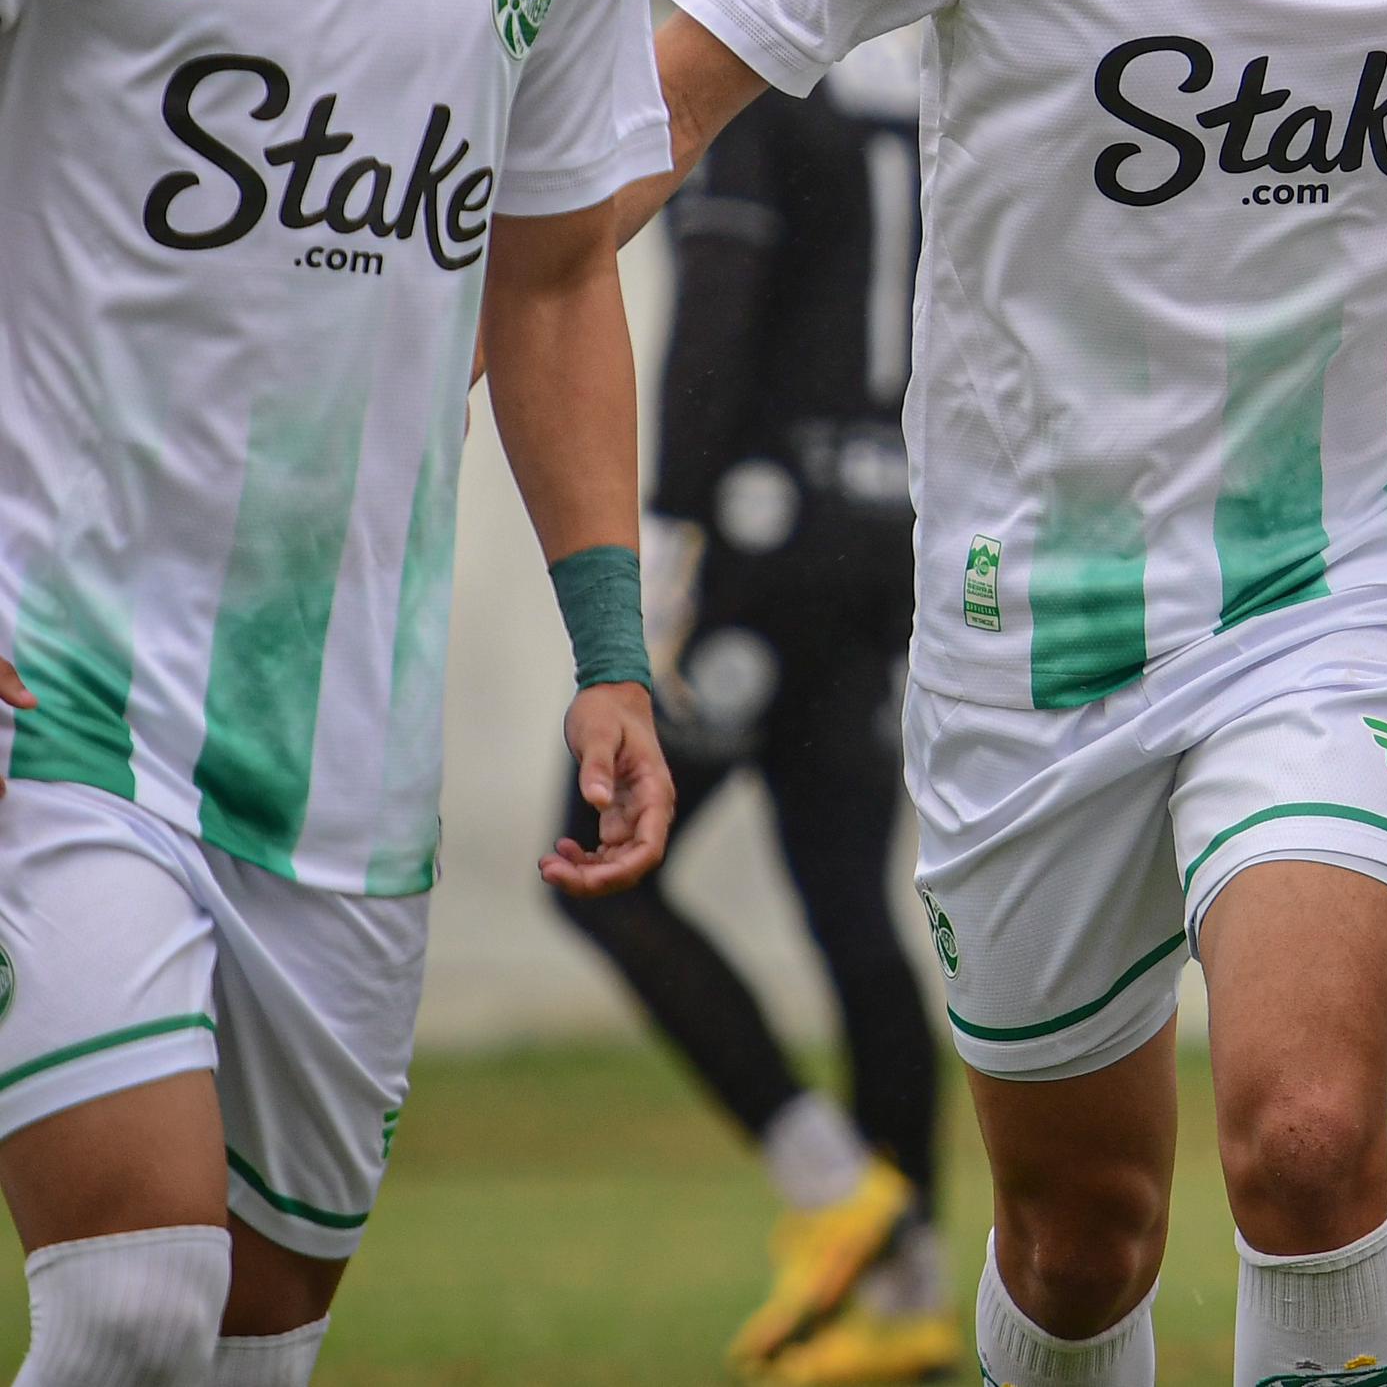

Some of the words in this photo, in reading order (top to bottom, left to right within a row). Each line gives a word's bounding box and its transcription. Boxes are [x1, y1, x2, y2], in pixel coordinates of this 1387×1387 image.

[144, 53, 493, 271] Stake
[1241, 182, 1330, 206] .com
[294, 245, 383, 275] .com
